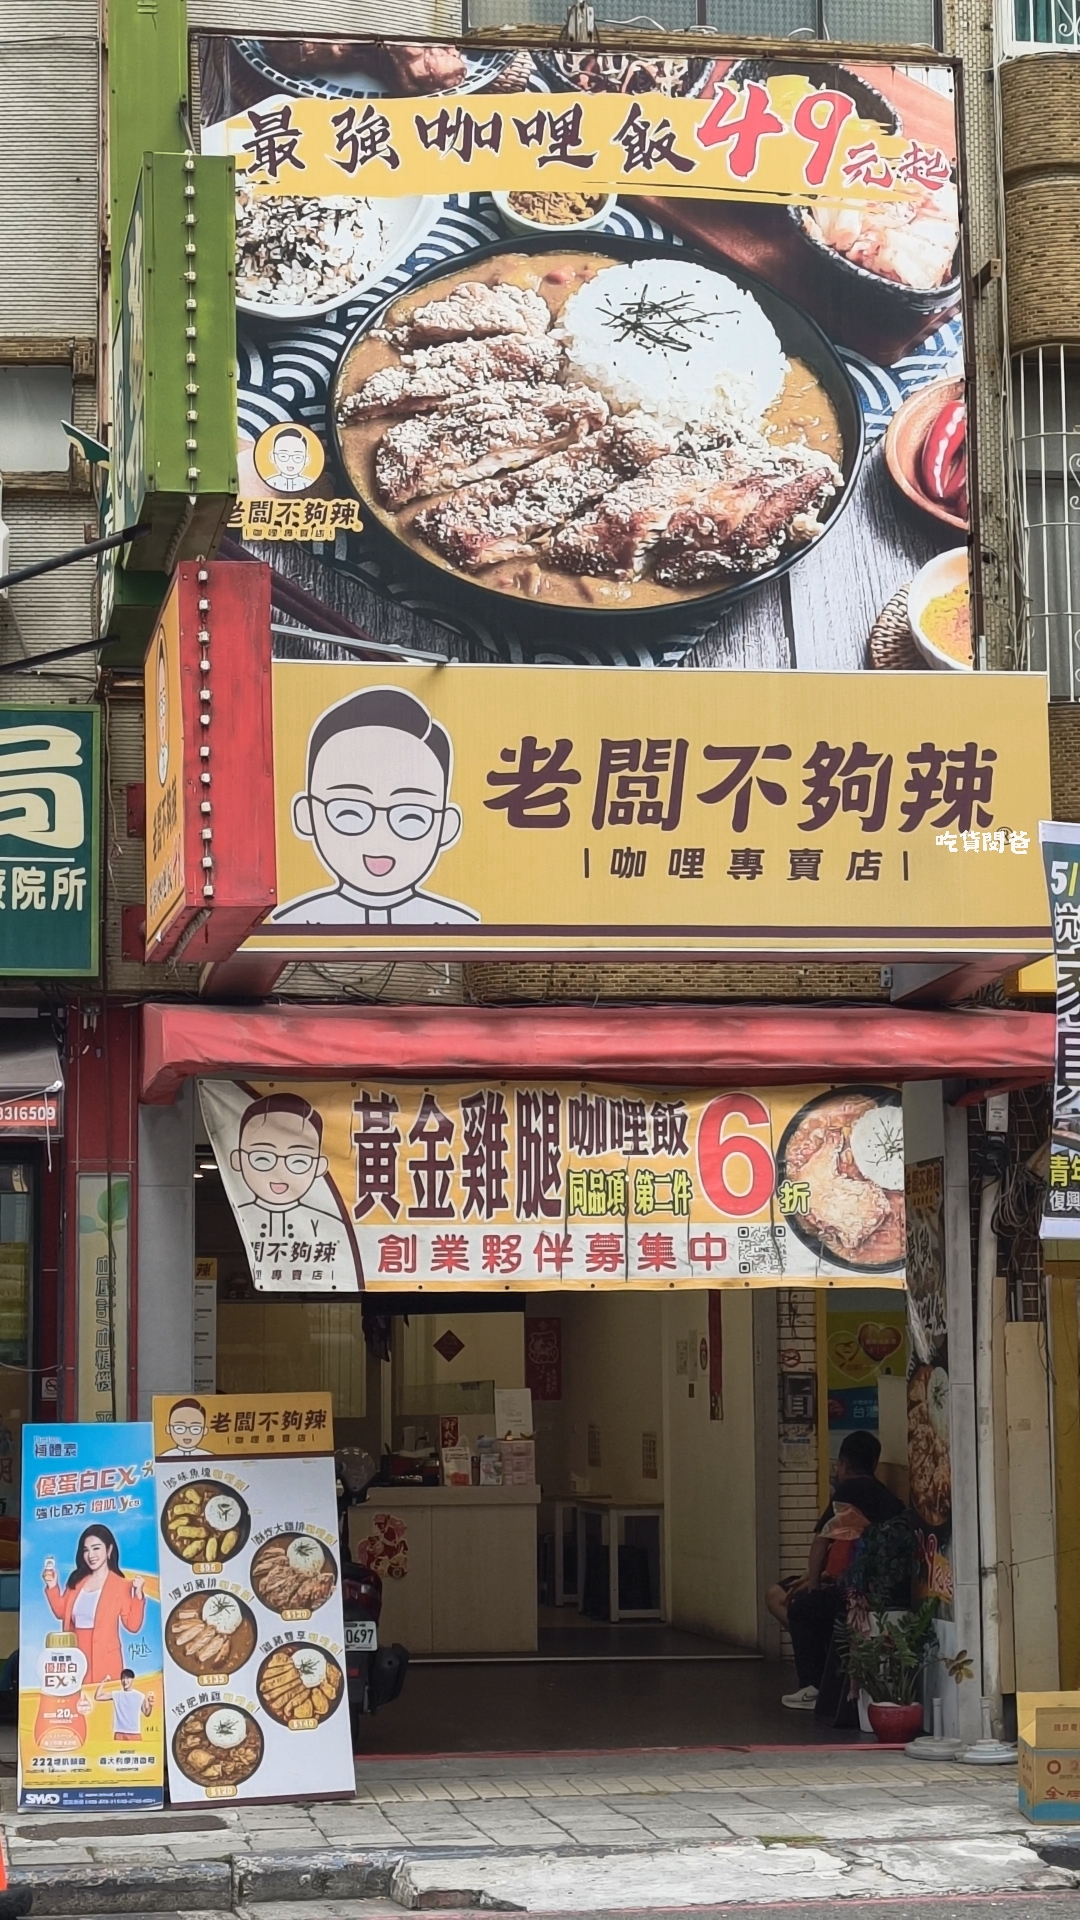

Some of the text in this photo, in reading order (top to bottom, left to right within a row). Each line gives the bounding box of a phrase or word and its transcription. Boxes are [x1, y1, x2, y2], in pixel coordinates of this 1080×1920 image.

[483, 736, 998, 833] 老闆不夠辣
[610, 848, 883, 881] 咖哩專賣店
[635, 1170, 692, 1216] 第二件
[378, 1232, 727, 1273] 創業夥伴募集中
[210, 1409, 327, 1433] 老闆不夠辣
